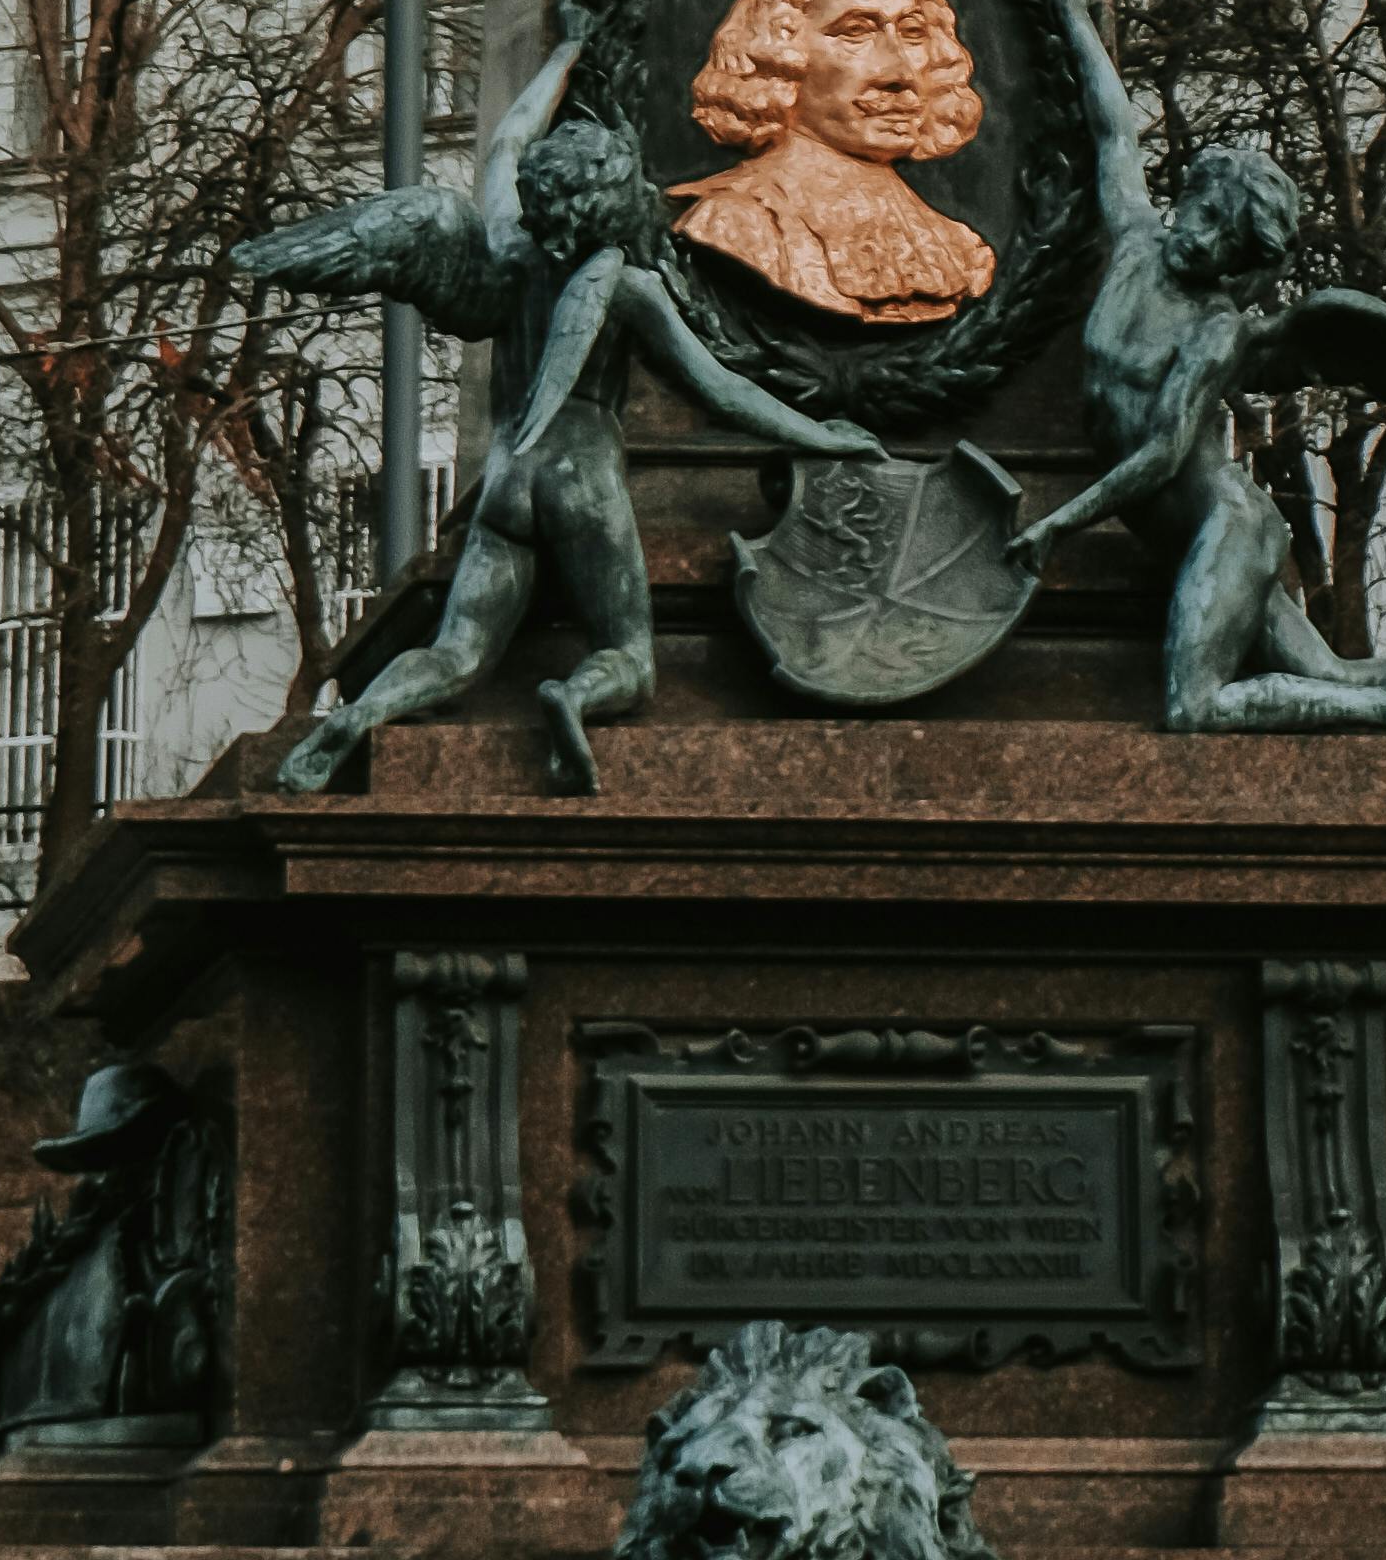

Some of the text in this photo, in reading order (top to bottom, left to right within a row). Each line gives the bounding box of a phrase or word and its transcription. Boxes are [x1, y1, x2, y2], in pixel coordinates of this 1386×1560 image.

[704, 1119, 1068, 1147] JOHANN ANDREAS
[722, 1155, 1087, 1207] LIEBENBERG
[940, 1215, 1011, 1243] VON
[1024, 1215, 1104, 1243] WIEN
[743, 1251, 863, 1279] JAHRE
